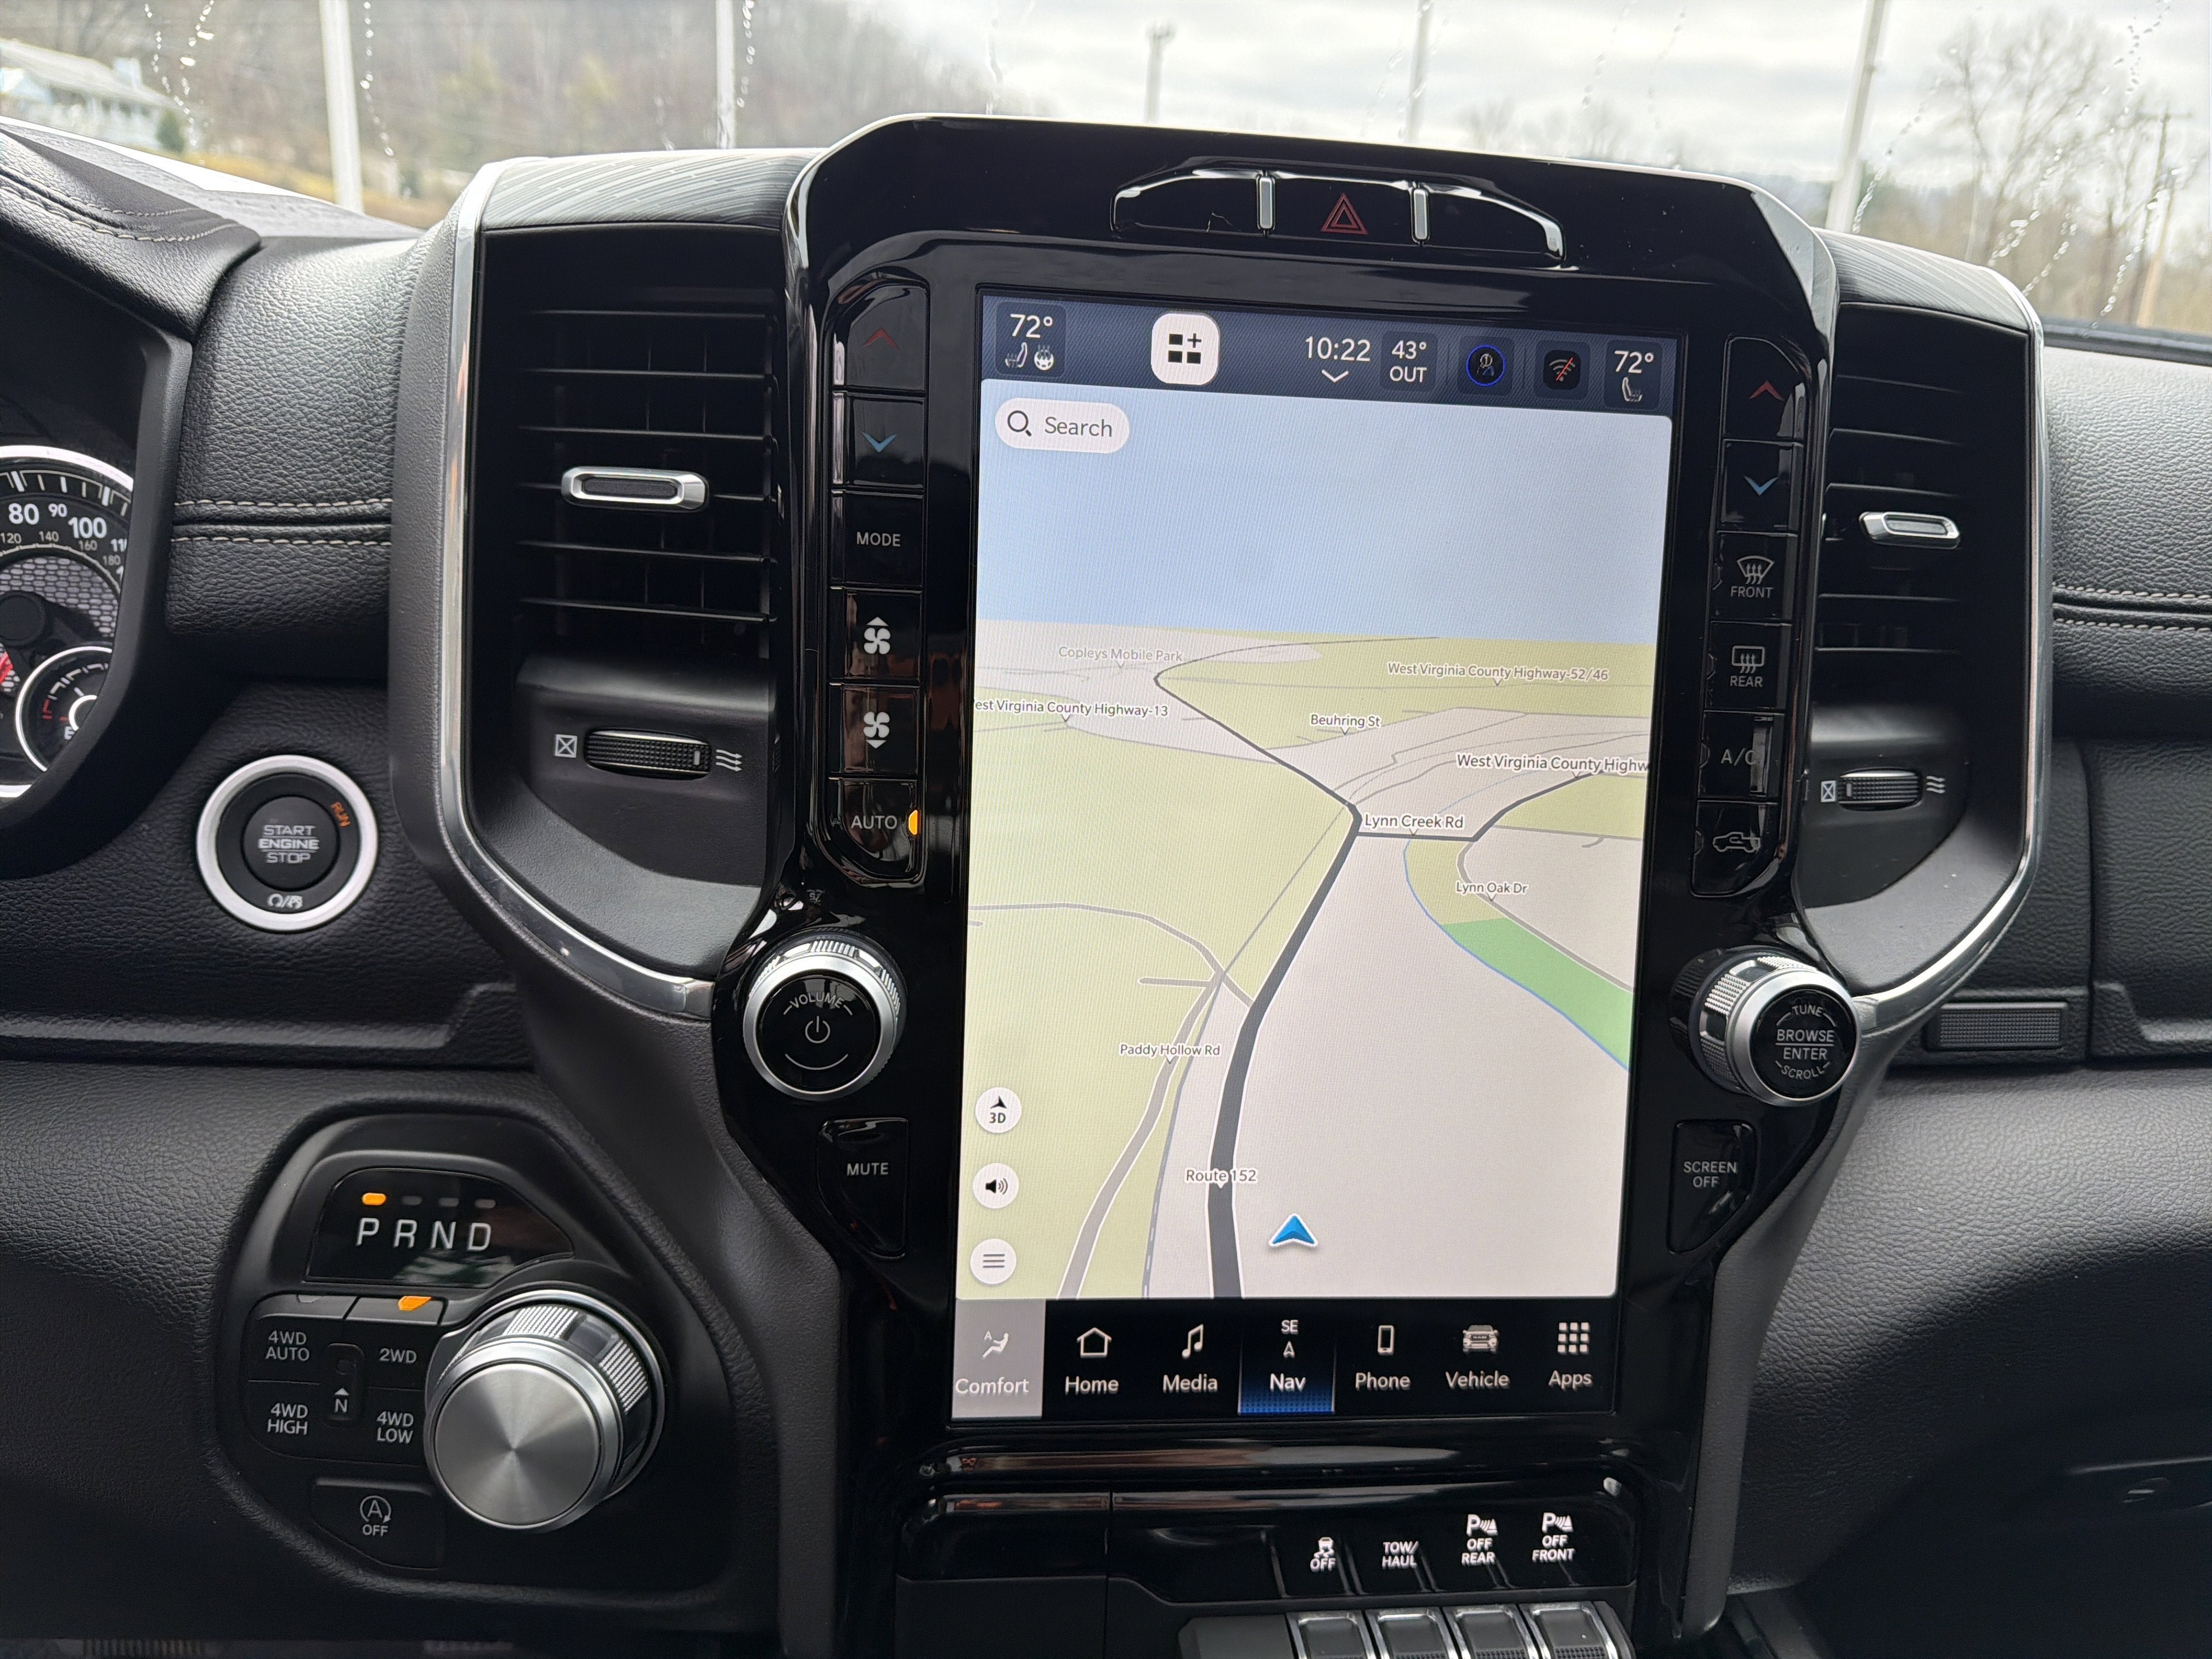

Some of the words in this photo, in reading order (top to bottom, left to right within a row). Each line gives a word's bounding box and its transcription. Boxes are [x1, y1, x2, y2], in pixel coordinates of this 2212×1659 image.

[1010, 313, 1053, 338] 72°
[1306, 335, 1370, 363] 10:22
[1391, 340, 1427, 360] 43°
[1614, 350, 1654, 374] 72°
[1389, 366, 1427, 383] OUT
[1045, 416, 1113, 438] Search
[8, 503, 40, 525] 80
[48, 503, 67, 517] 90
[68, 517, 107, 539] 100
[1, 532, 21, 544] 120
[39, 531, 59, 543] 140
[856, 531, 901, 548] MODE
[78, 540, 98, 551] 160
[111, 538, 127, 552] 11
[1730, 586, 1773, 599] FRONT
[1058, 646, 1108, 661] Copleys
[1110, 648, 1153, 662] Mobile
[1155, 650, 1183, 662] Park
[1388, 663, 1418, 675] West
[1420, 664, 1465, 679] Virginia
[1468, 665, 1511, 680] County
[1514, 667, 1608, 682] Highway-52/46
[1729, 675, 1763, 688] REAR
[974, 699, 994, 710] est
[996, 699, 1043, 715] Virginia
[1047, 701, 1092, 716] County
[1094, 702, 1168, 718] Highway-13
[1311, 714, 1364, 729] Beuhring
[1367, 716, 1380, 726] St
[1457, 754, 1491, 768] West
[1494, 755, 1547, 772] Virginia
[1550, 757, 1601, 773] County
[1720, 747, 1757, 766] A/C
[331, 802, 351, 827] RUN
[850, 814, 898, 830] AUTO
[1365, 814, 1397, 828] Lynn
[1401, 815, 1442, 828] Creek
[1445, 815, 1464, 828] Rd
[263, 825, 316, 836] START
[257, 838, 320, 850] ENGINE
[267, 853, 311, 864] STOP
[1456, 882, 1484, 895] Lynn
[1486, 882, 1511, 893] Oak
[1514, 883, 1528, 894] Dr
[790, 992, 845, 1009] VOLUME
[1791, 1003, 1824, 1018] TUNE
[1777, 1029, 1835, 1042] BROWSE
[1120, 1044, 1158, 1057] Paddy
[1160, 1045, 1201, 1056] Hollow
[1204, 1045, 1220, 1056] Rd
[1784, 1048, 1828, 1060] ENTER
[1780, 1064, 1825, 1080] SCROLL
[989, 1113, 1006, 1124] 3D
[847, 1162, 889, 1176] MUTE
[1683, 1162, 1737, 1173] SCREEN
[1186, 1170, 1227, 1182] Route
[1231, 1170, 1256, 1182] 152
[1692, 1176, 1719, 1188] OFF
[357, 1217, 379, 1246] P
[393, 1220, 418, 1248] R
[430, 1221, 456, 1250] N
[467, 1223, 492, 1252] D
[1281, 1319, 1299, 1334] SE
[268, 1330, 307, 1346] 4WD
[266, 1347, 310, 1362] AUTO
[380, 1348, 417, 1364] 2WD
[955, 1378, 1029, 1396] Comfort
[1065, 1377, 1119, 1394] Home
[1163, 1375, 1218, 1393] Media
[1269, 1374, 1306, 1391] Nav
[1355, 1373, 1411, 1391] Phone
[1445, 1370, 1510, 1389] Vehicle
[1548, 1370, 1592, 1390] Apps
[270, 1403, 308, 1419] 4WD
[334, 1399, 348, 1413] N
[377, 1410, 414, 1427] 4WD
[267, 1419, 308, 1435] HIGH
[377, 1427, 413, 1444] LOW
[362, 1523, 388, 1536] OFF
[1383, 1541, 1419, 1554] TOW/
[1466, 1538, 1493, 1551] OFF
[1542, 1536, 1567, 1548] OFF
[1382, 1555, 1417, 1568] HAUL
[1462, 1551, 1496, 1566] REAR
[1532, 1548, 1575, 1562] FRONT
[1310, 1557, 1336, 1572] OFF
